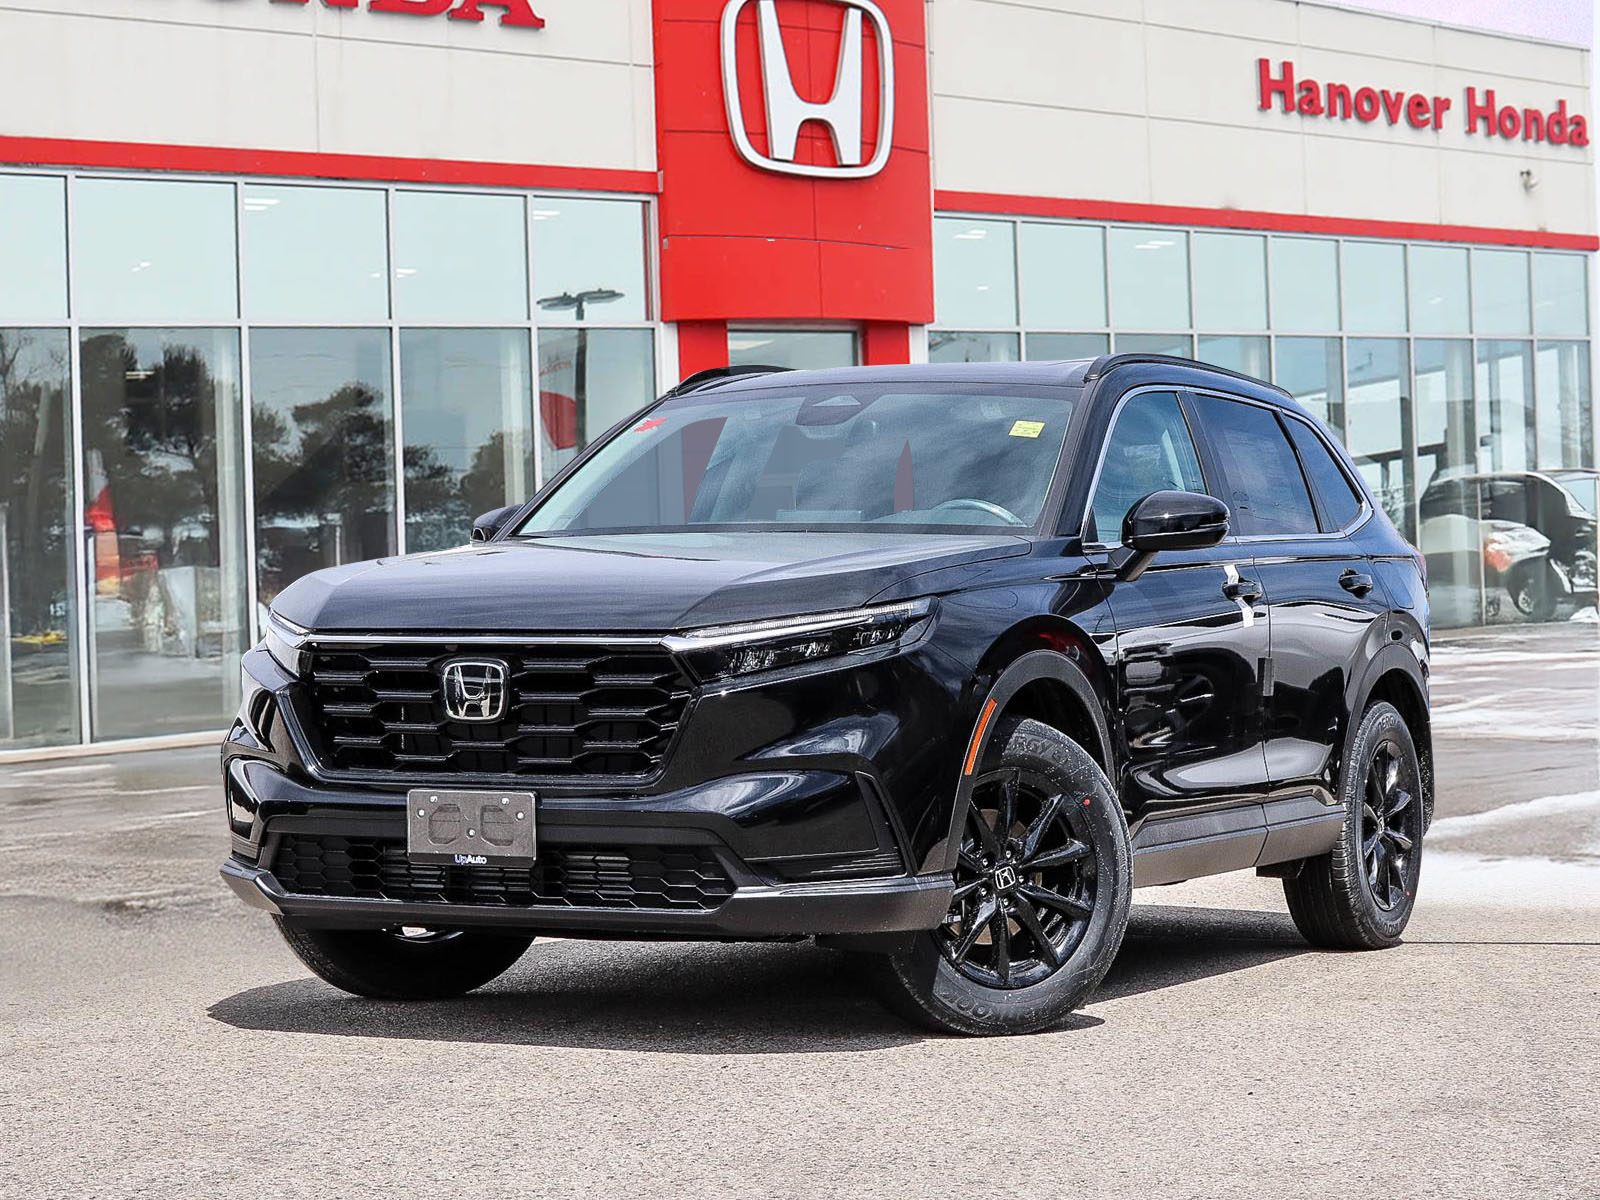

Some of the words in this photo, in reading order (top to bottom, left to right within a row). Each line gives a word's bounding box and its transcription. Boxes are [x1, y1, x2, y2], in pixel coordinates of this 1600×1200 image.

[1258, 57, 1452, 131] Hanover
[1464, 86, 1590, 147] Honda
[454, 854, 488, 865] UpAuto
